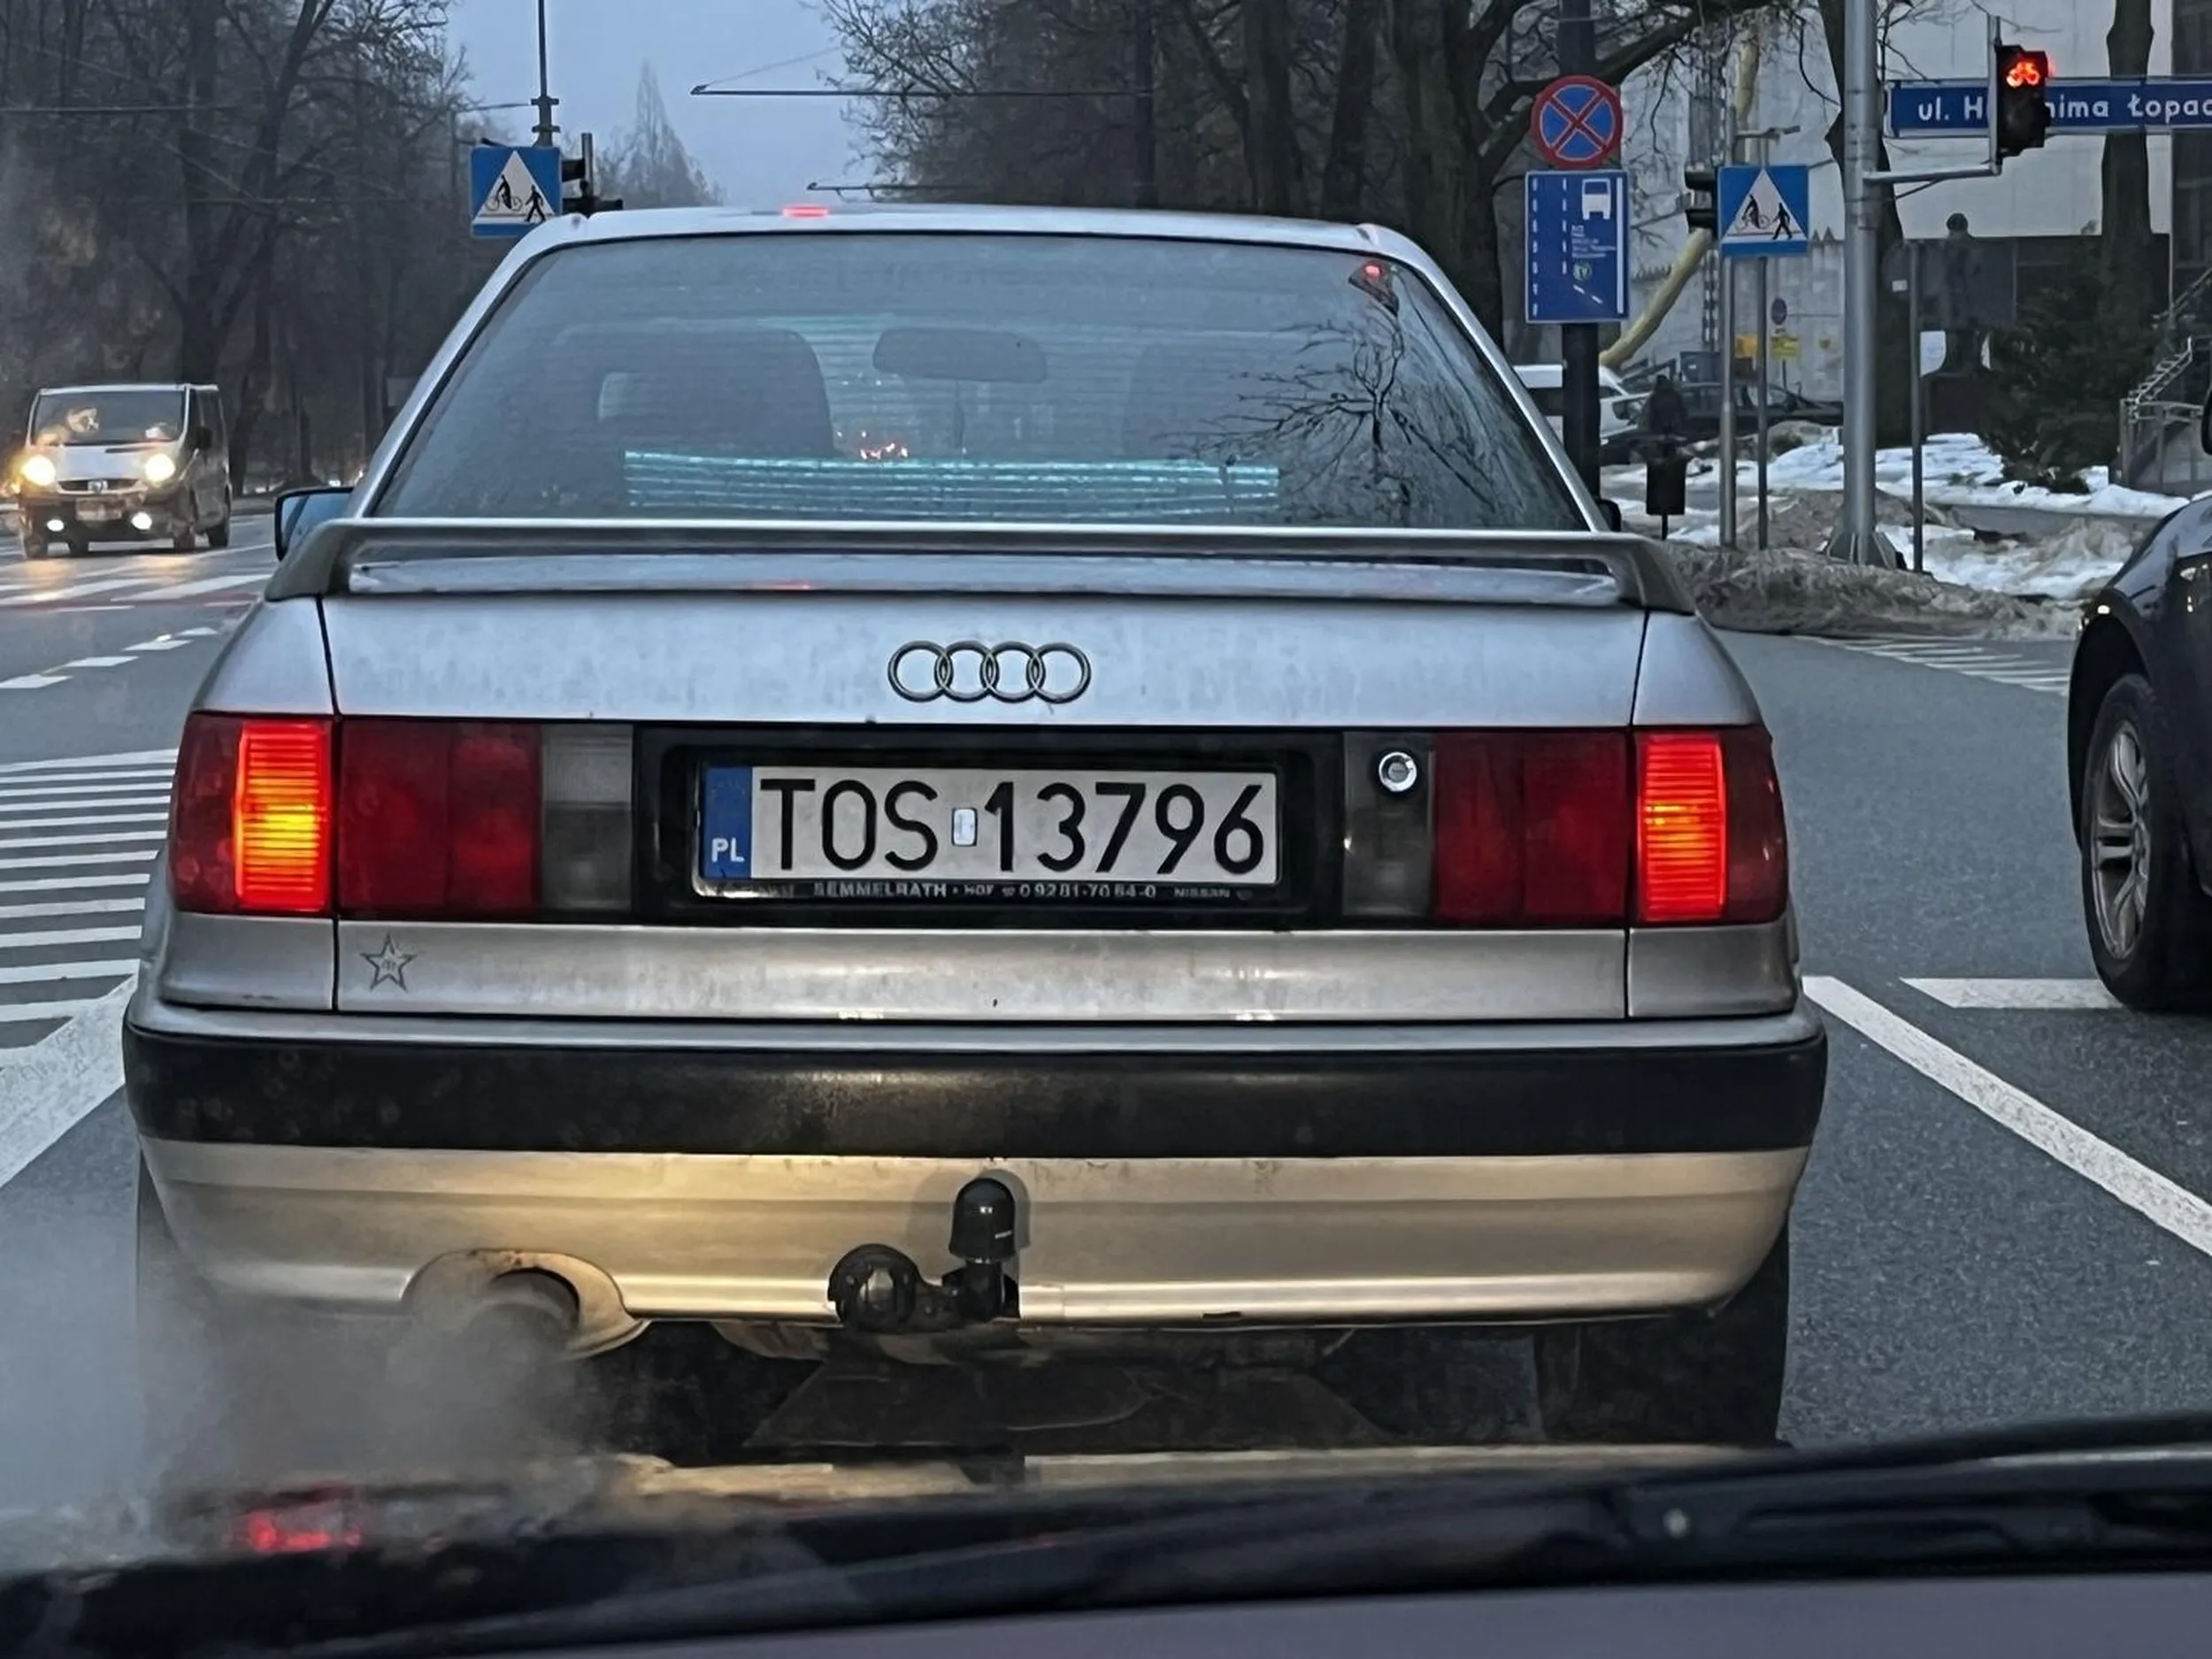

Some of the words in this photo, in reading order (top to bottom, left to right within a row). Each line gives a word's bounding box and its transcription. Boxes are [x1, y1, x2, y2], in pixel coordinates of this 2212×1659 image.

[1917, 96, 1949, 121] ul.
[759, 778, 939, 872] TOS
[984, 780, 1265, 875] 13796
[710, 837, 745, 864] PL
